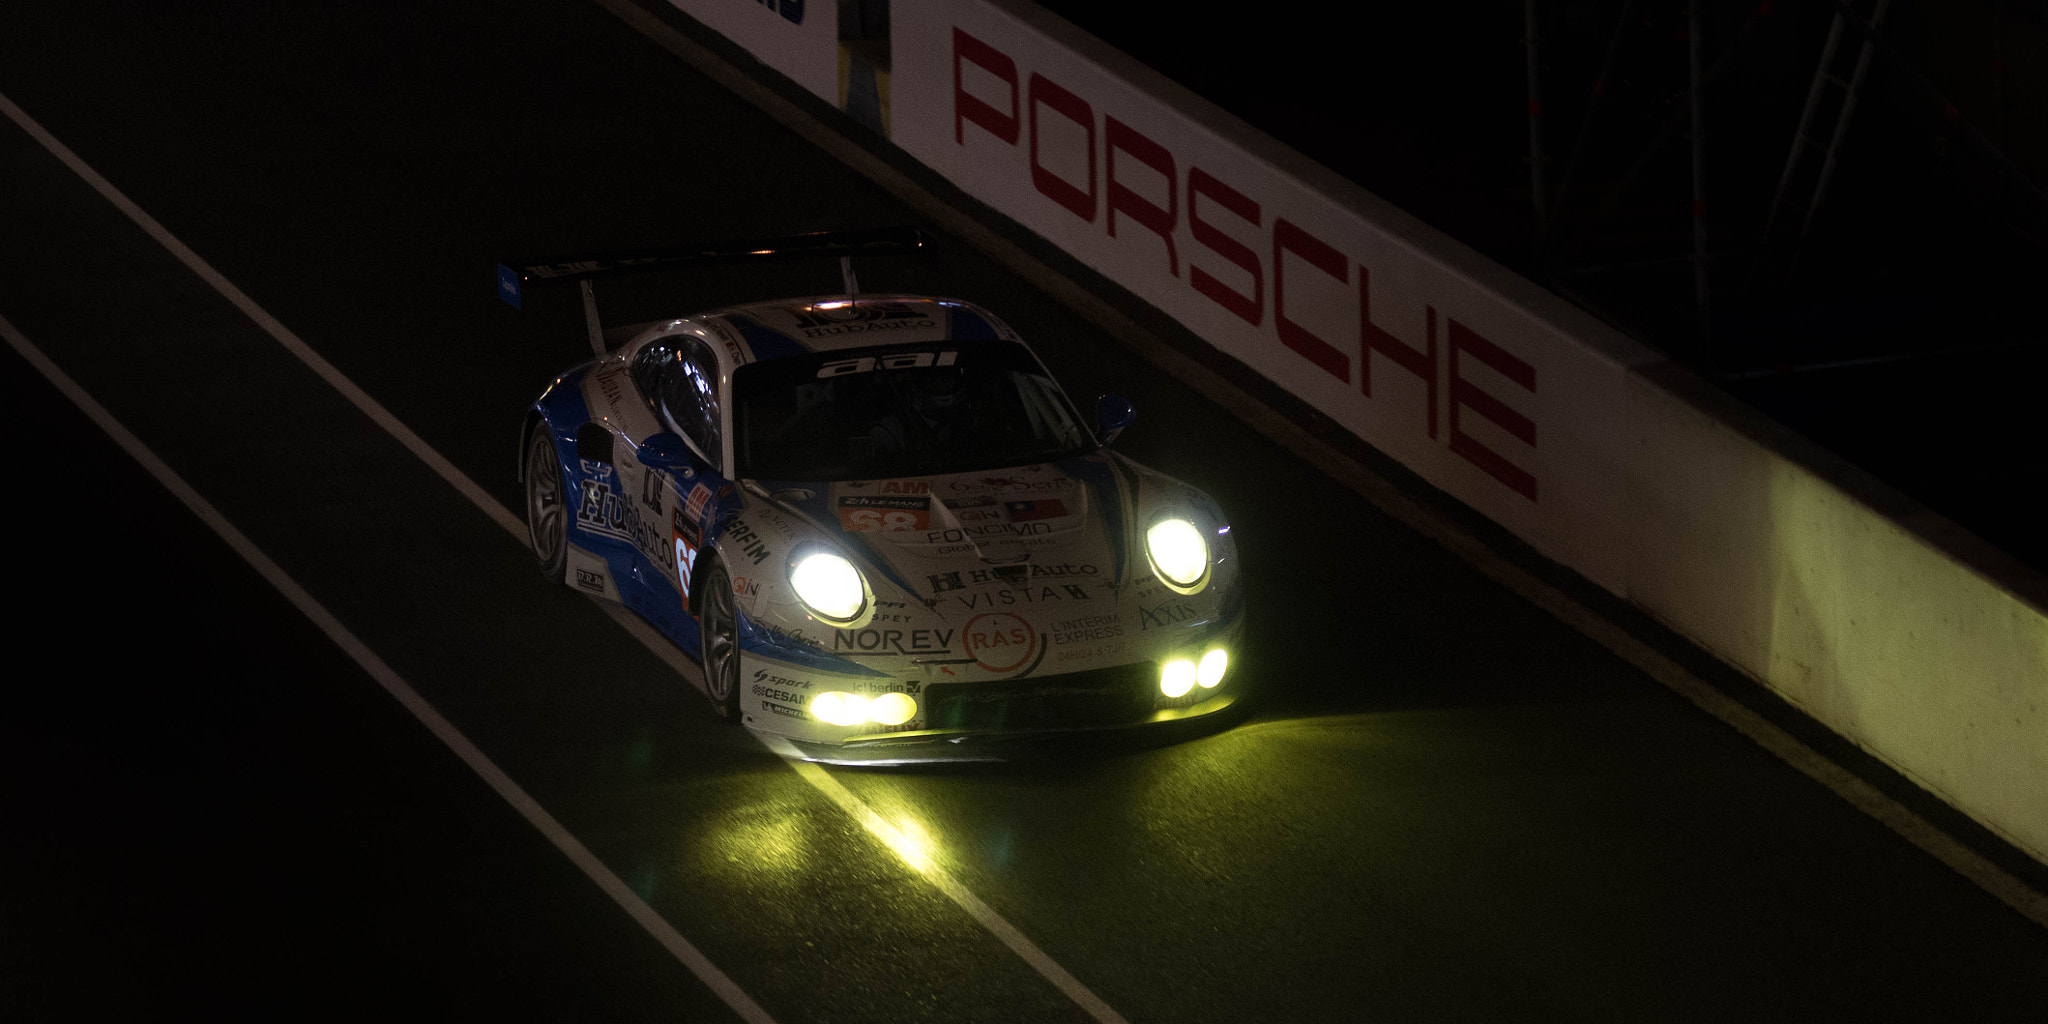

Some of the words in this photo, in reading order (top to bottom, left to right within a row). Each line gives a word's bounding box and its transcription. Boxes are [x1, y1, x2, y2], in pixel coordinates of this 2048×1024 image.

[953, 27, 1537, 502] PORSCHE
[804, 319, 936, 338] HubAuto
[881, 481, 929, 494] AM
[849, 510, 918, 535] 68
[958, 586, 1062, 610] VISTA
[871, 613, 912, 623] SPEY
[834, 628, 954, 652] NOREV
[971, 628, 1027, 650] RAS
[1054, 625, 1123, 645] EXPRESS
[768, 674, 813, 690] spark
[869, 681, 904, 693] berlin
